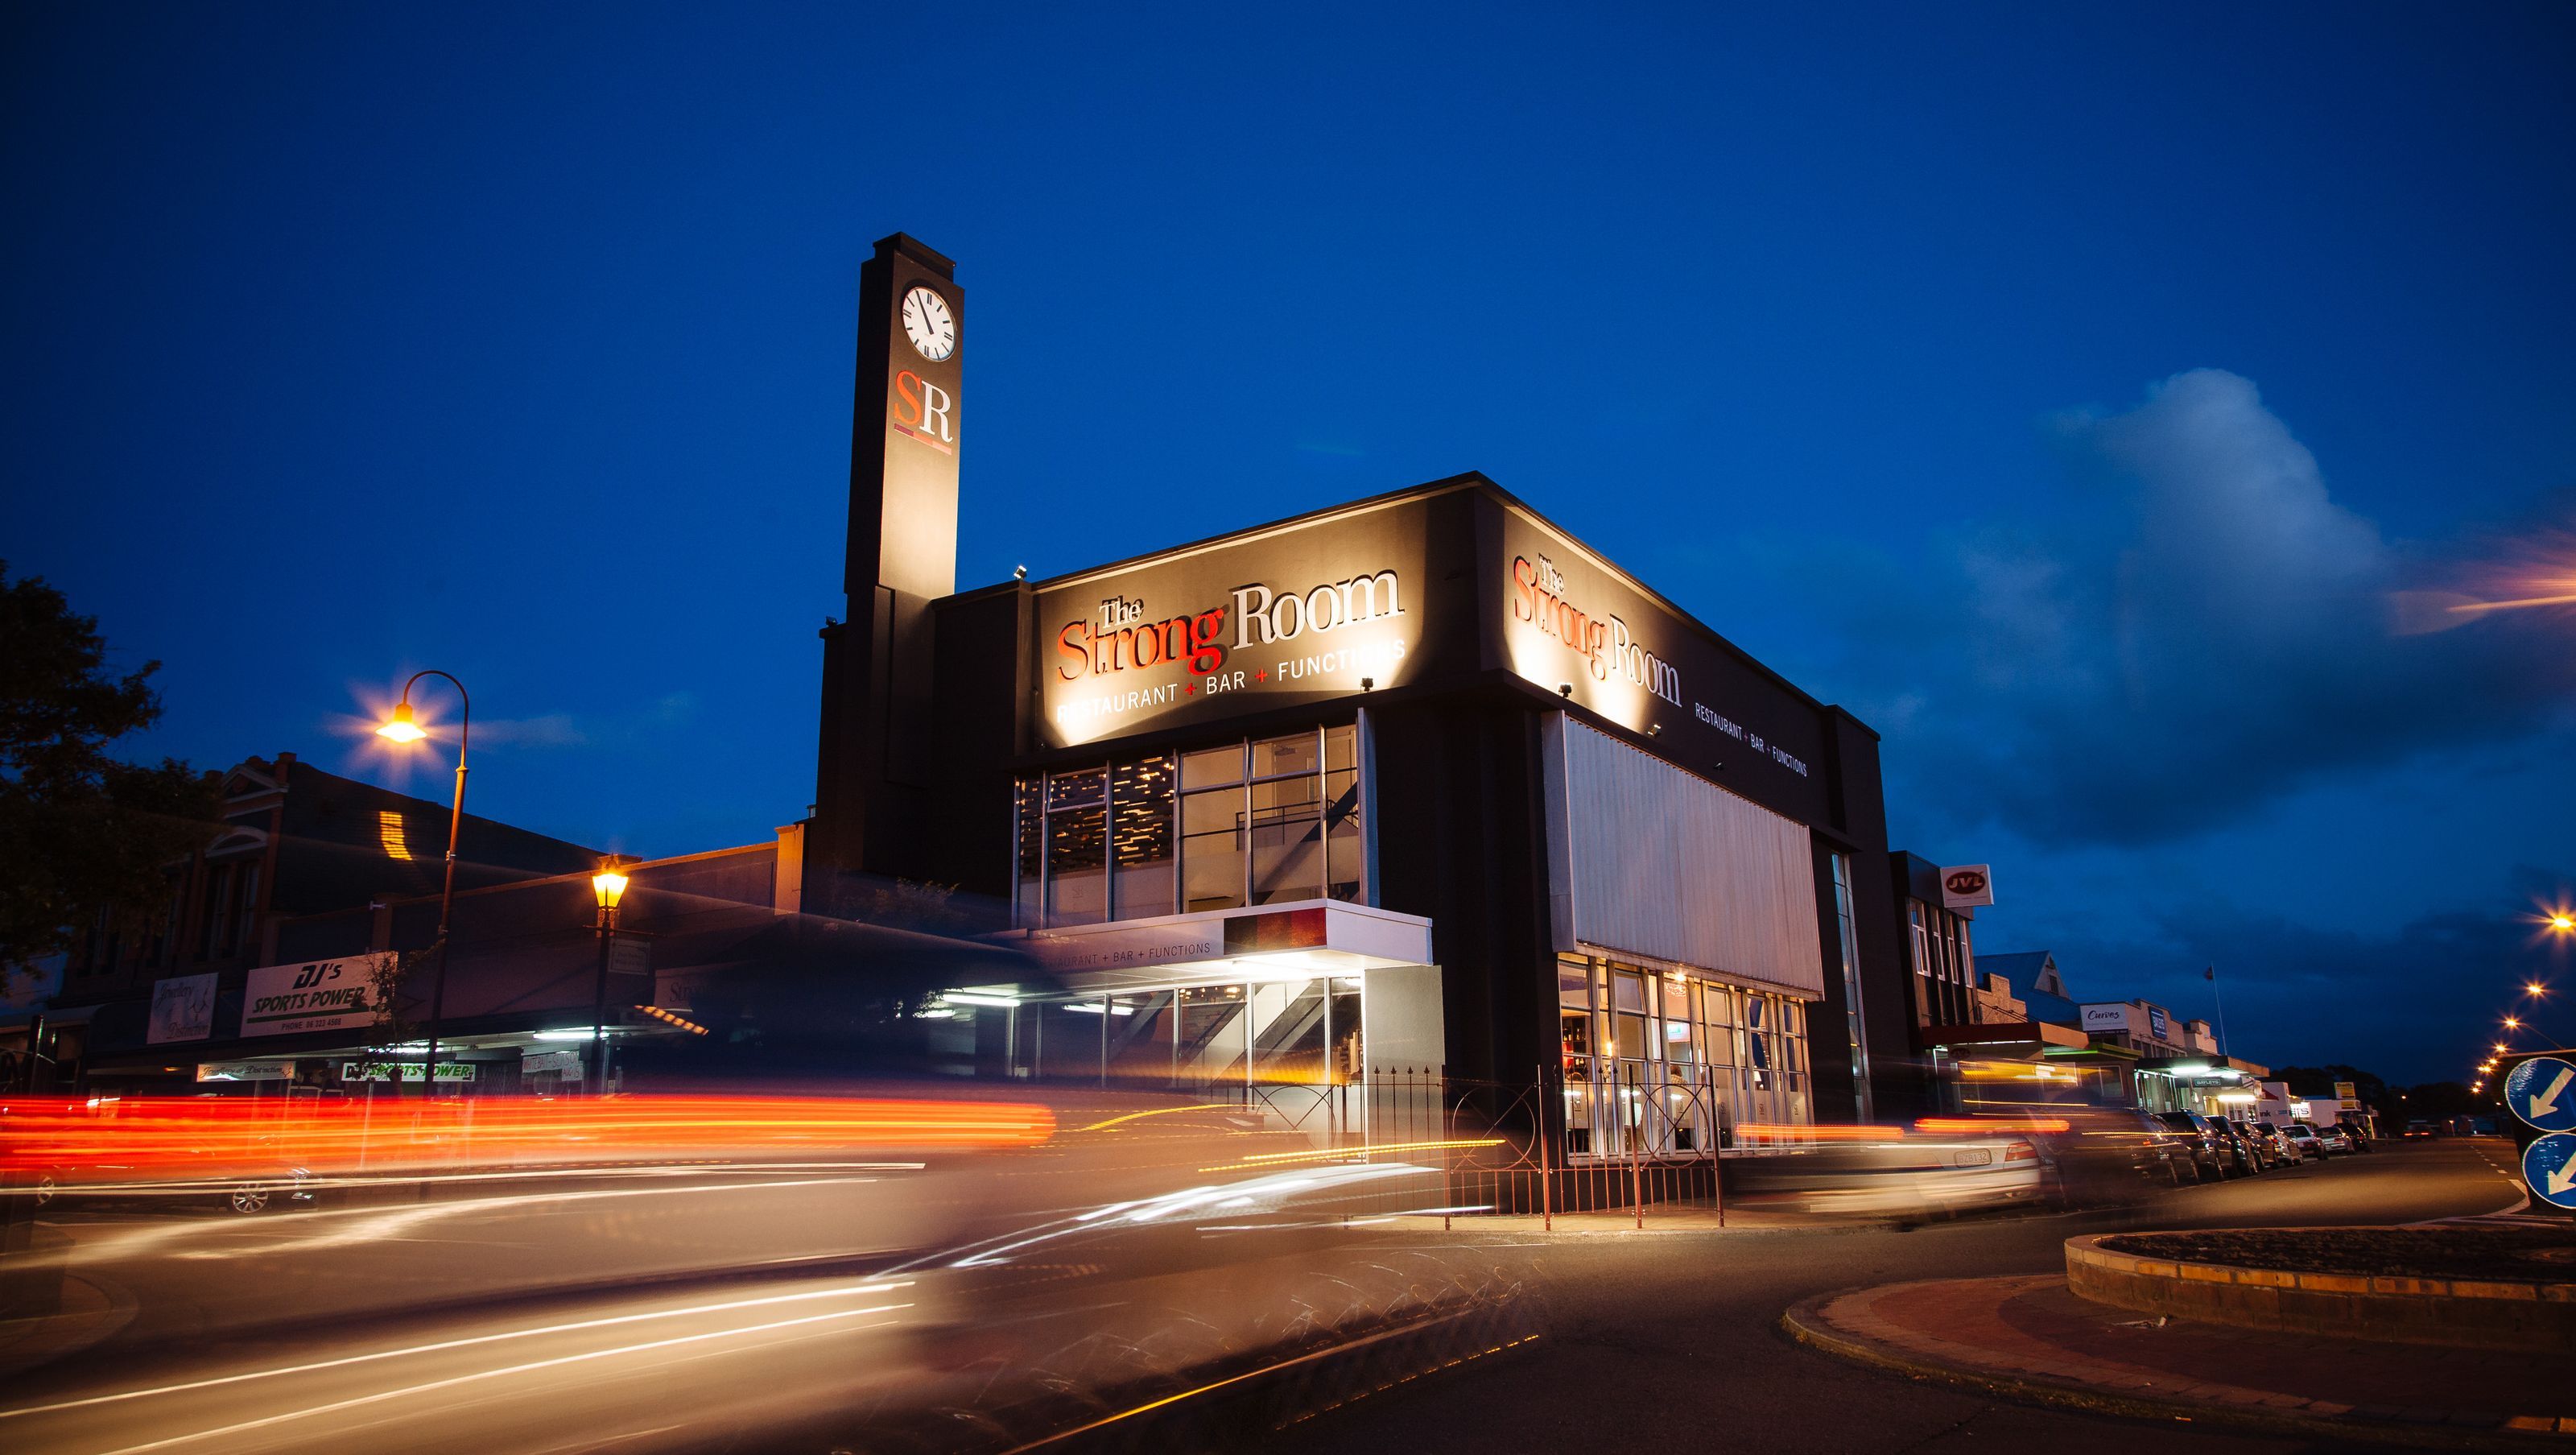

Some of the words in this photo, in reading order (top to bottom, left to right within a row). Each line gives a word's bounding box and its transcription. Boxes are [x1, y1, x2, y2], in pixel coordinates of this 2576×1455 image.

[894, 370, 952, 443] SR
[1539, 556, 1564, 595] The
[1057, 608, 1224, 684] Strong
[1232, 571, 1405, 650] Room
[1099, 598, 1142, 629] The
[1514, 557, 1608, 682] Strong
[1611, 615, 1682, 708] Room
[1057, 683, 1178, 723] RSTAURANT
[1207, 671, 1245, 694] BAR
[1278, 638, 1405, 681] FUNCTIS
[1695, 702, 1743, 742] RESTAURANT
[1750, 734, 1764, 753] BAR
[1773, 746, 1807, 778] FUNCTIONS
[1113, 951, 1133, 962] BAR
[1150, 943, 1211, 958] FUNCTIONS
[293, 963, 342, 990] DJ's
[253, 993, 308, 1013] SPORTS
[2087, 1010, 2120, 1020] Curves
[282, 1021, 303, 1031] PHONE
